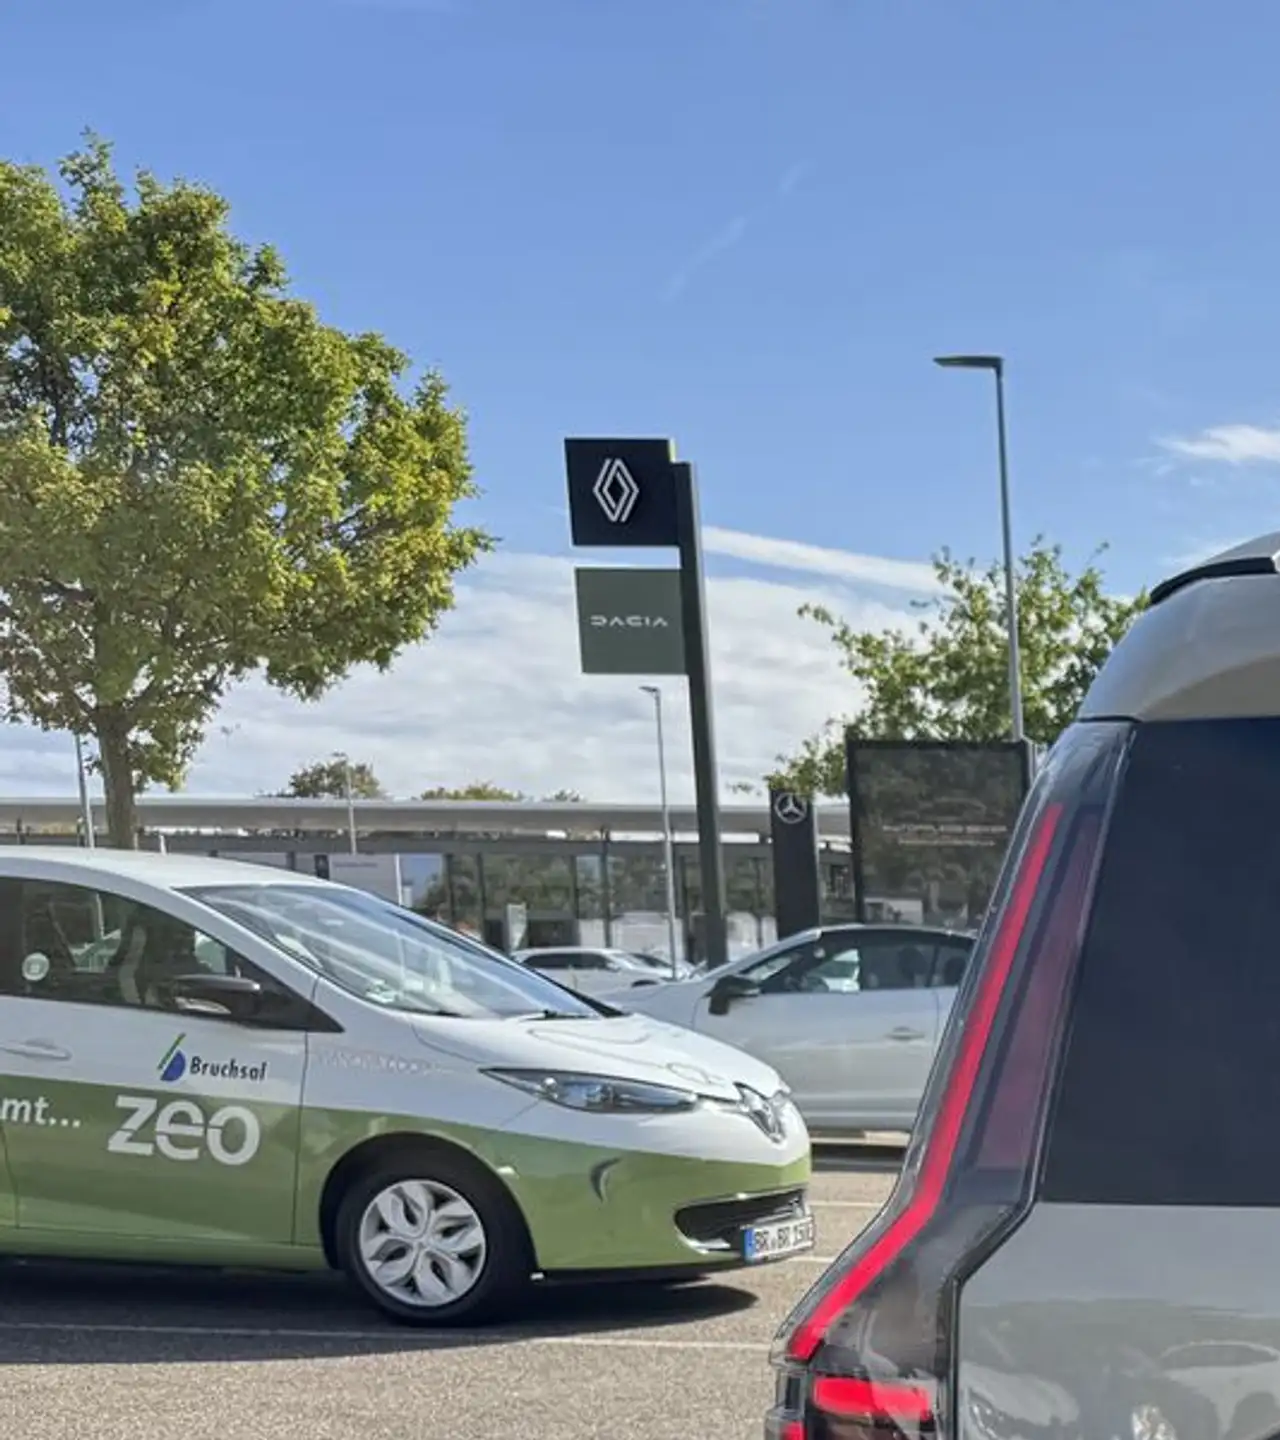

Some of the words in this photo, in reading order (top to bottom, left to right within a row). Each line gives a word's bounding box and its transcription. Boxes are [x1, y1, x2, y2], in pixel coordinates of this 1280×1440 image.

[590, 614, 668, 628] DACIA
[189, 1056, 267, 1081] Bruchsal
[107, 1095, 260, 1166] zeo
